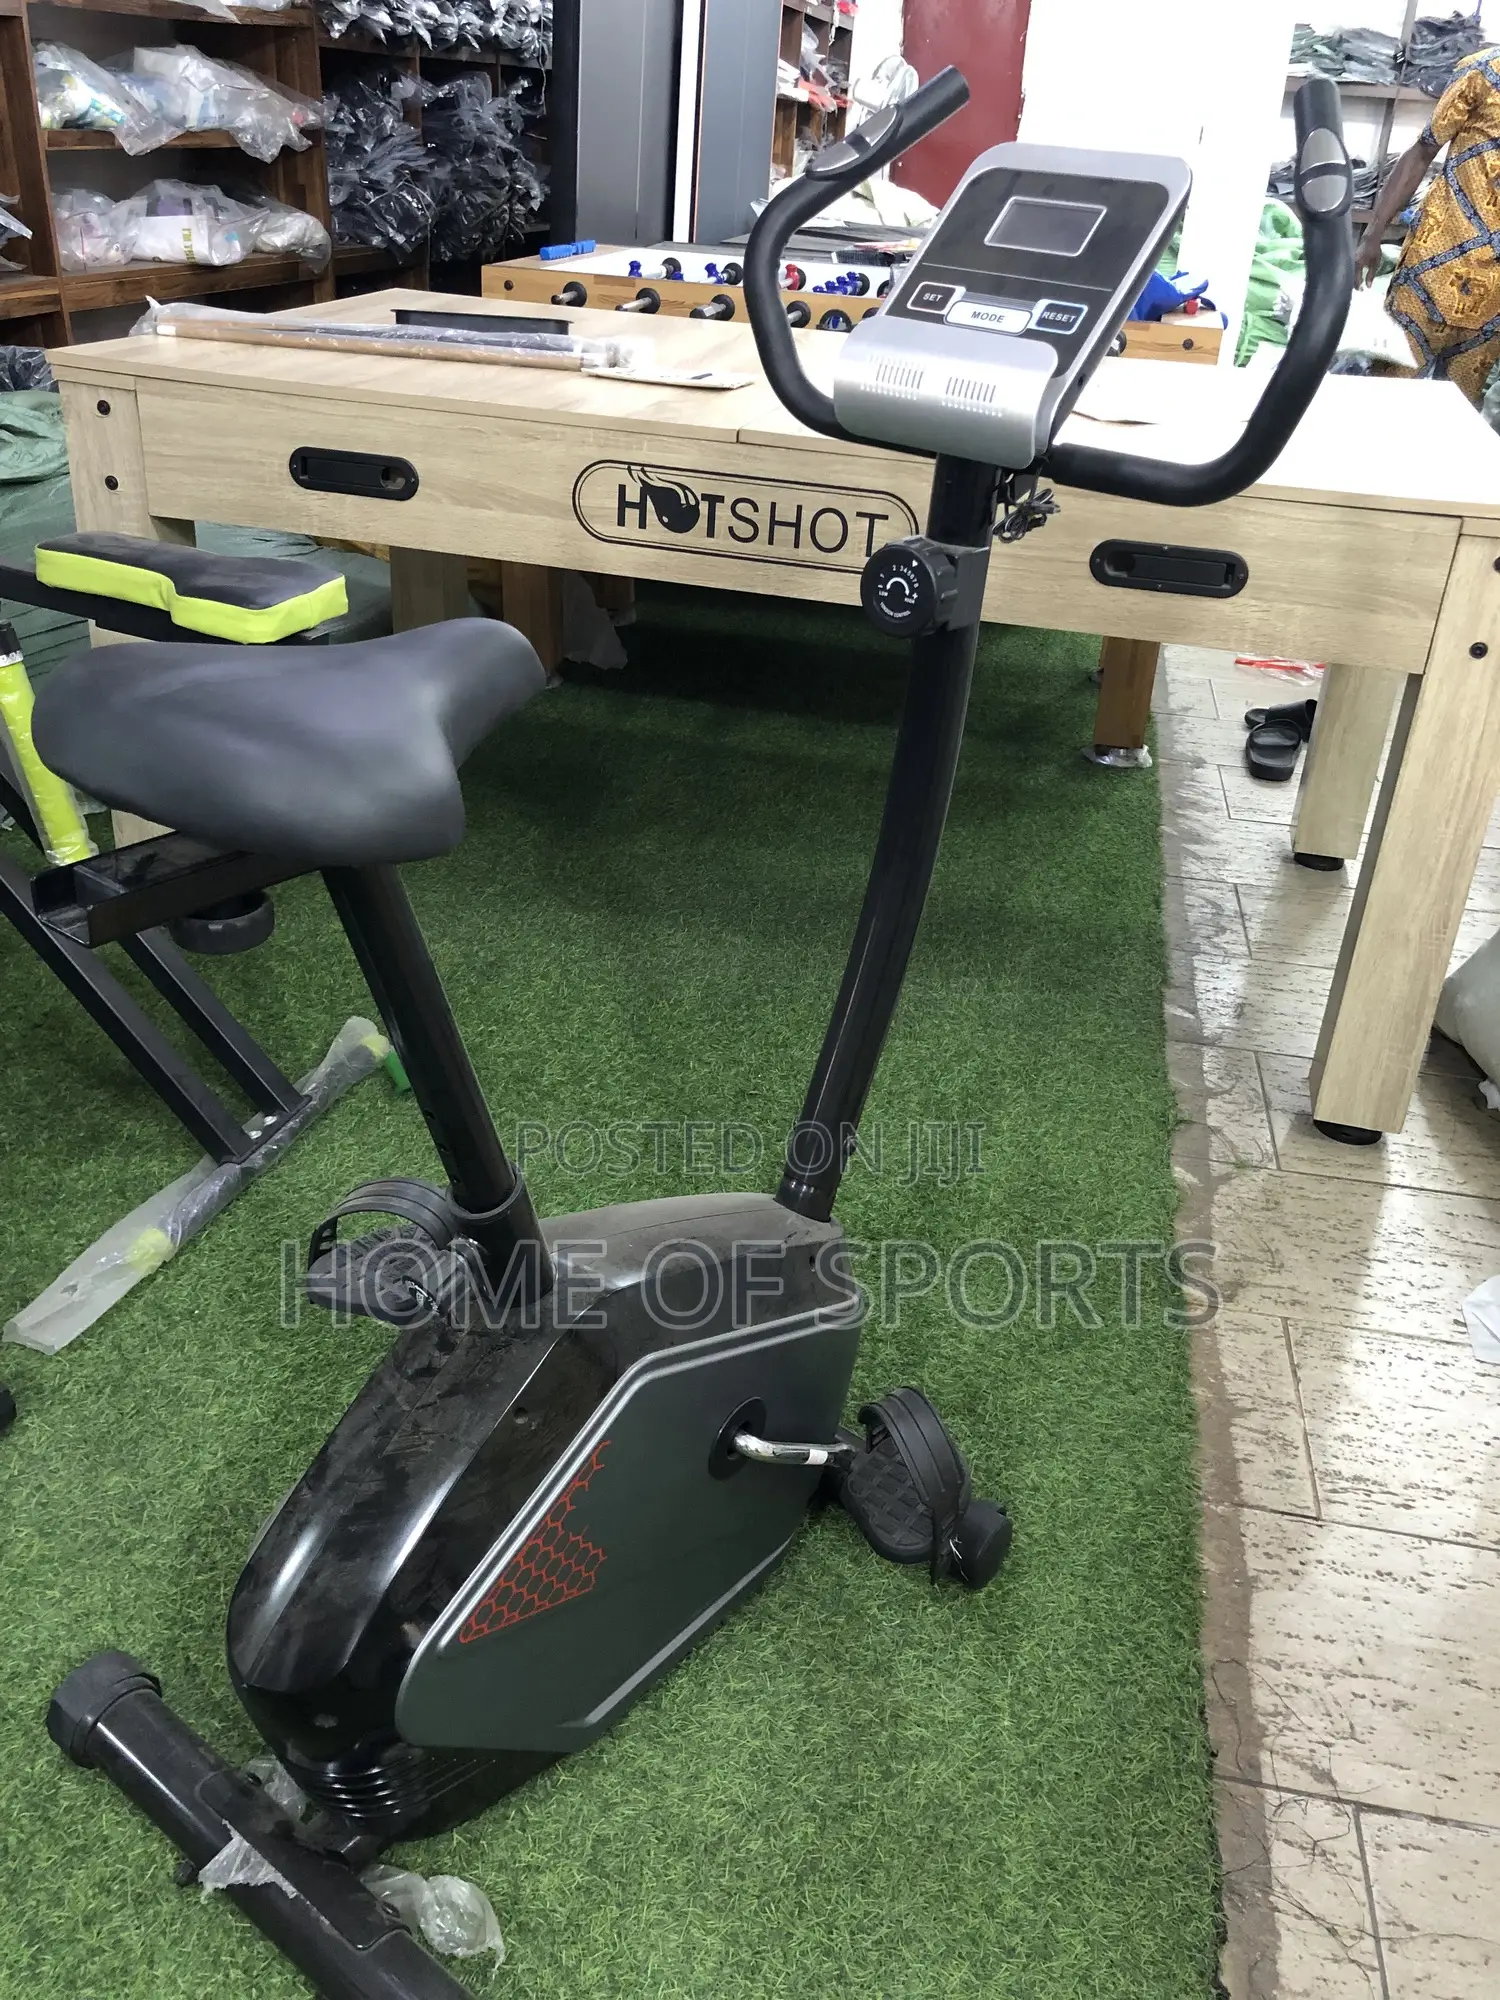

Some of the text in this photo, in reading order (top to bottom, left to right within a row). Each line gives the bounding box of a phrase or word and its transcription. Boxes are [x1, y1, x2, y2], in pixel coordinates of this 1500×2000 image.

[922, 292, 943, 303] SET
[970, 310, 1006, 324] MODE
[1041, 311, 1078, 324] RESET
